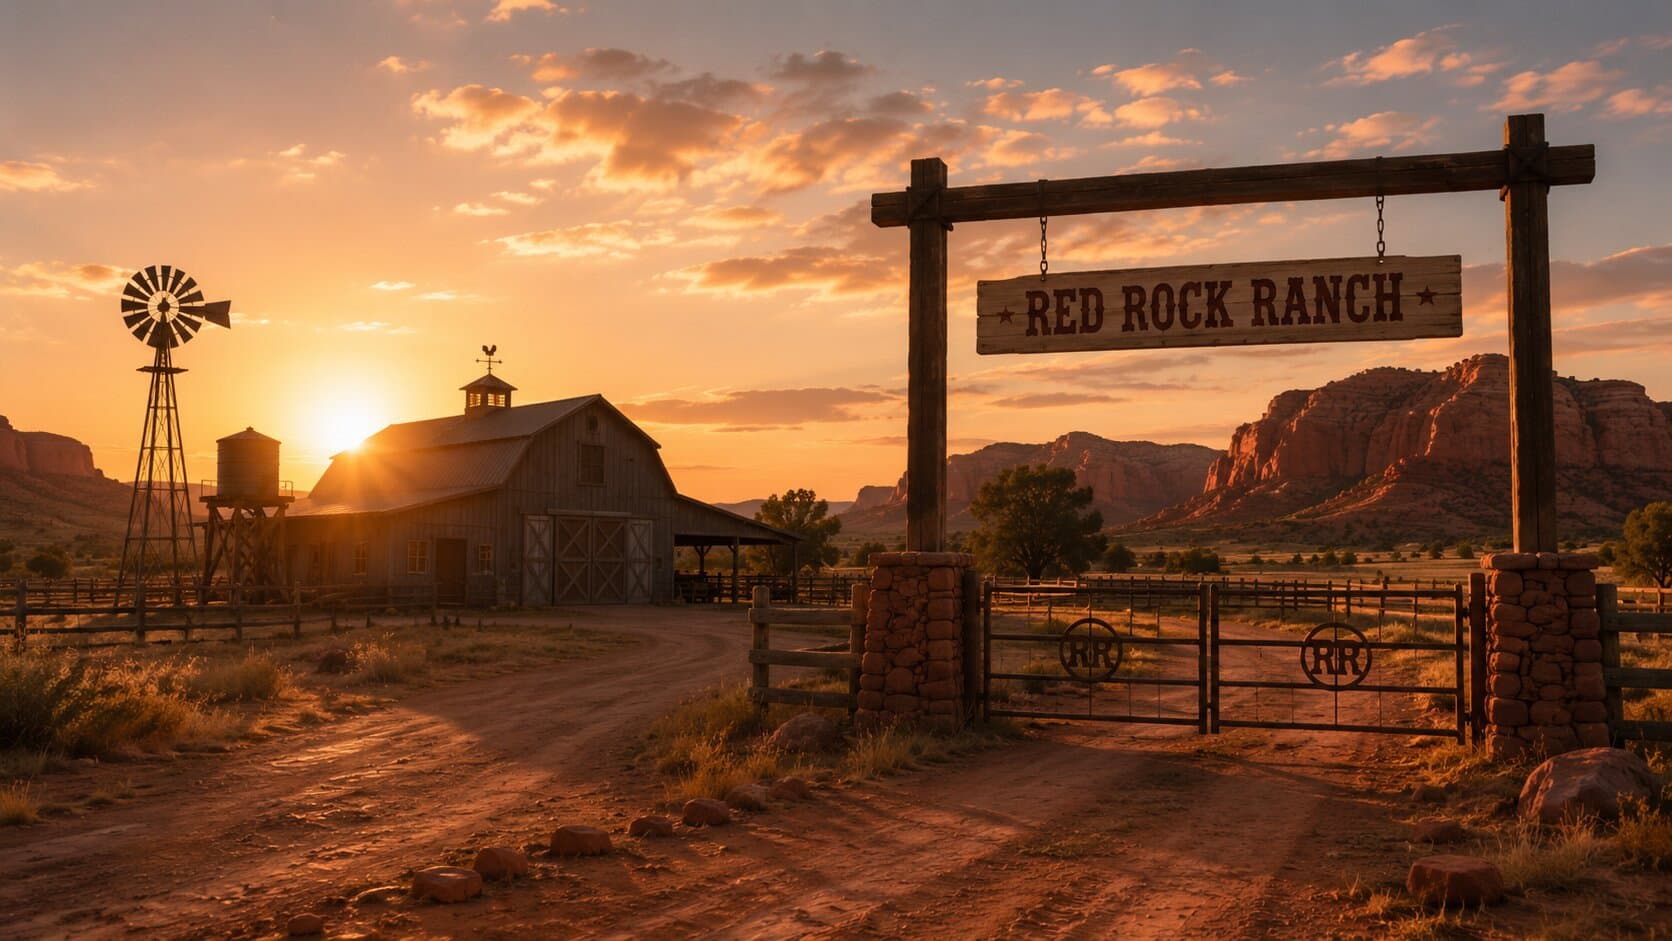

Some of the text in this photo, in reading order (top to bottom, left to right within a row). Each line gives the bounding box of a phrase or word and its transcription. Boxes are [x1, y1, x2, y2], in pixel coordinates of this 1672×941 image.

[1025, 272, 1404, 337] RED ROCK RANCH
[1066, 636, 1115, 668] RR
[1310, 639, 1362, 675] RR
